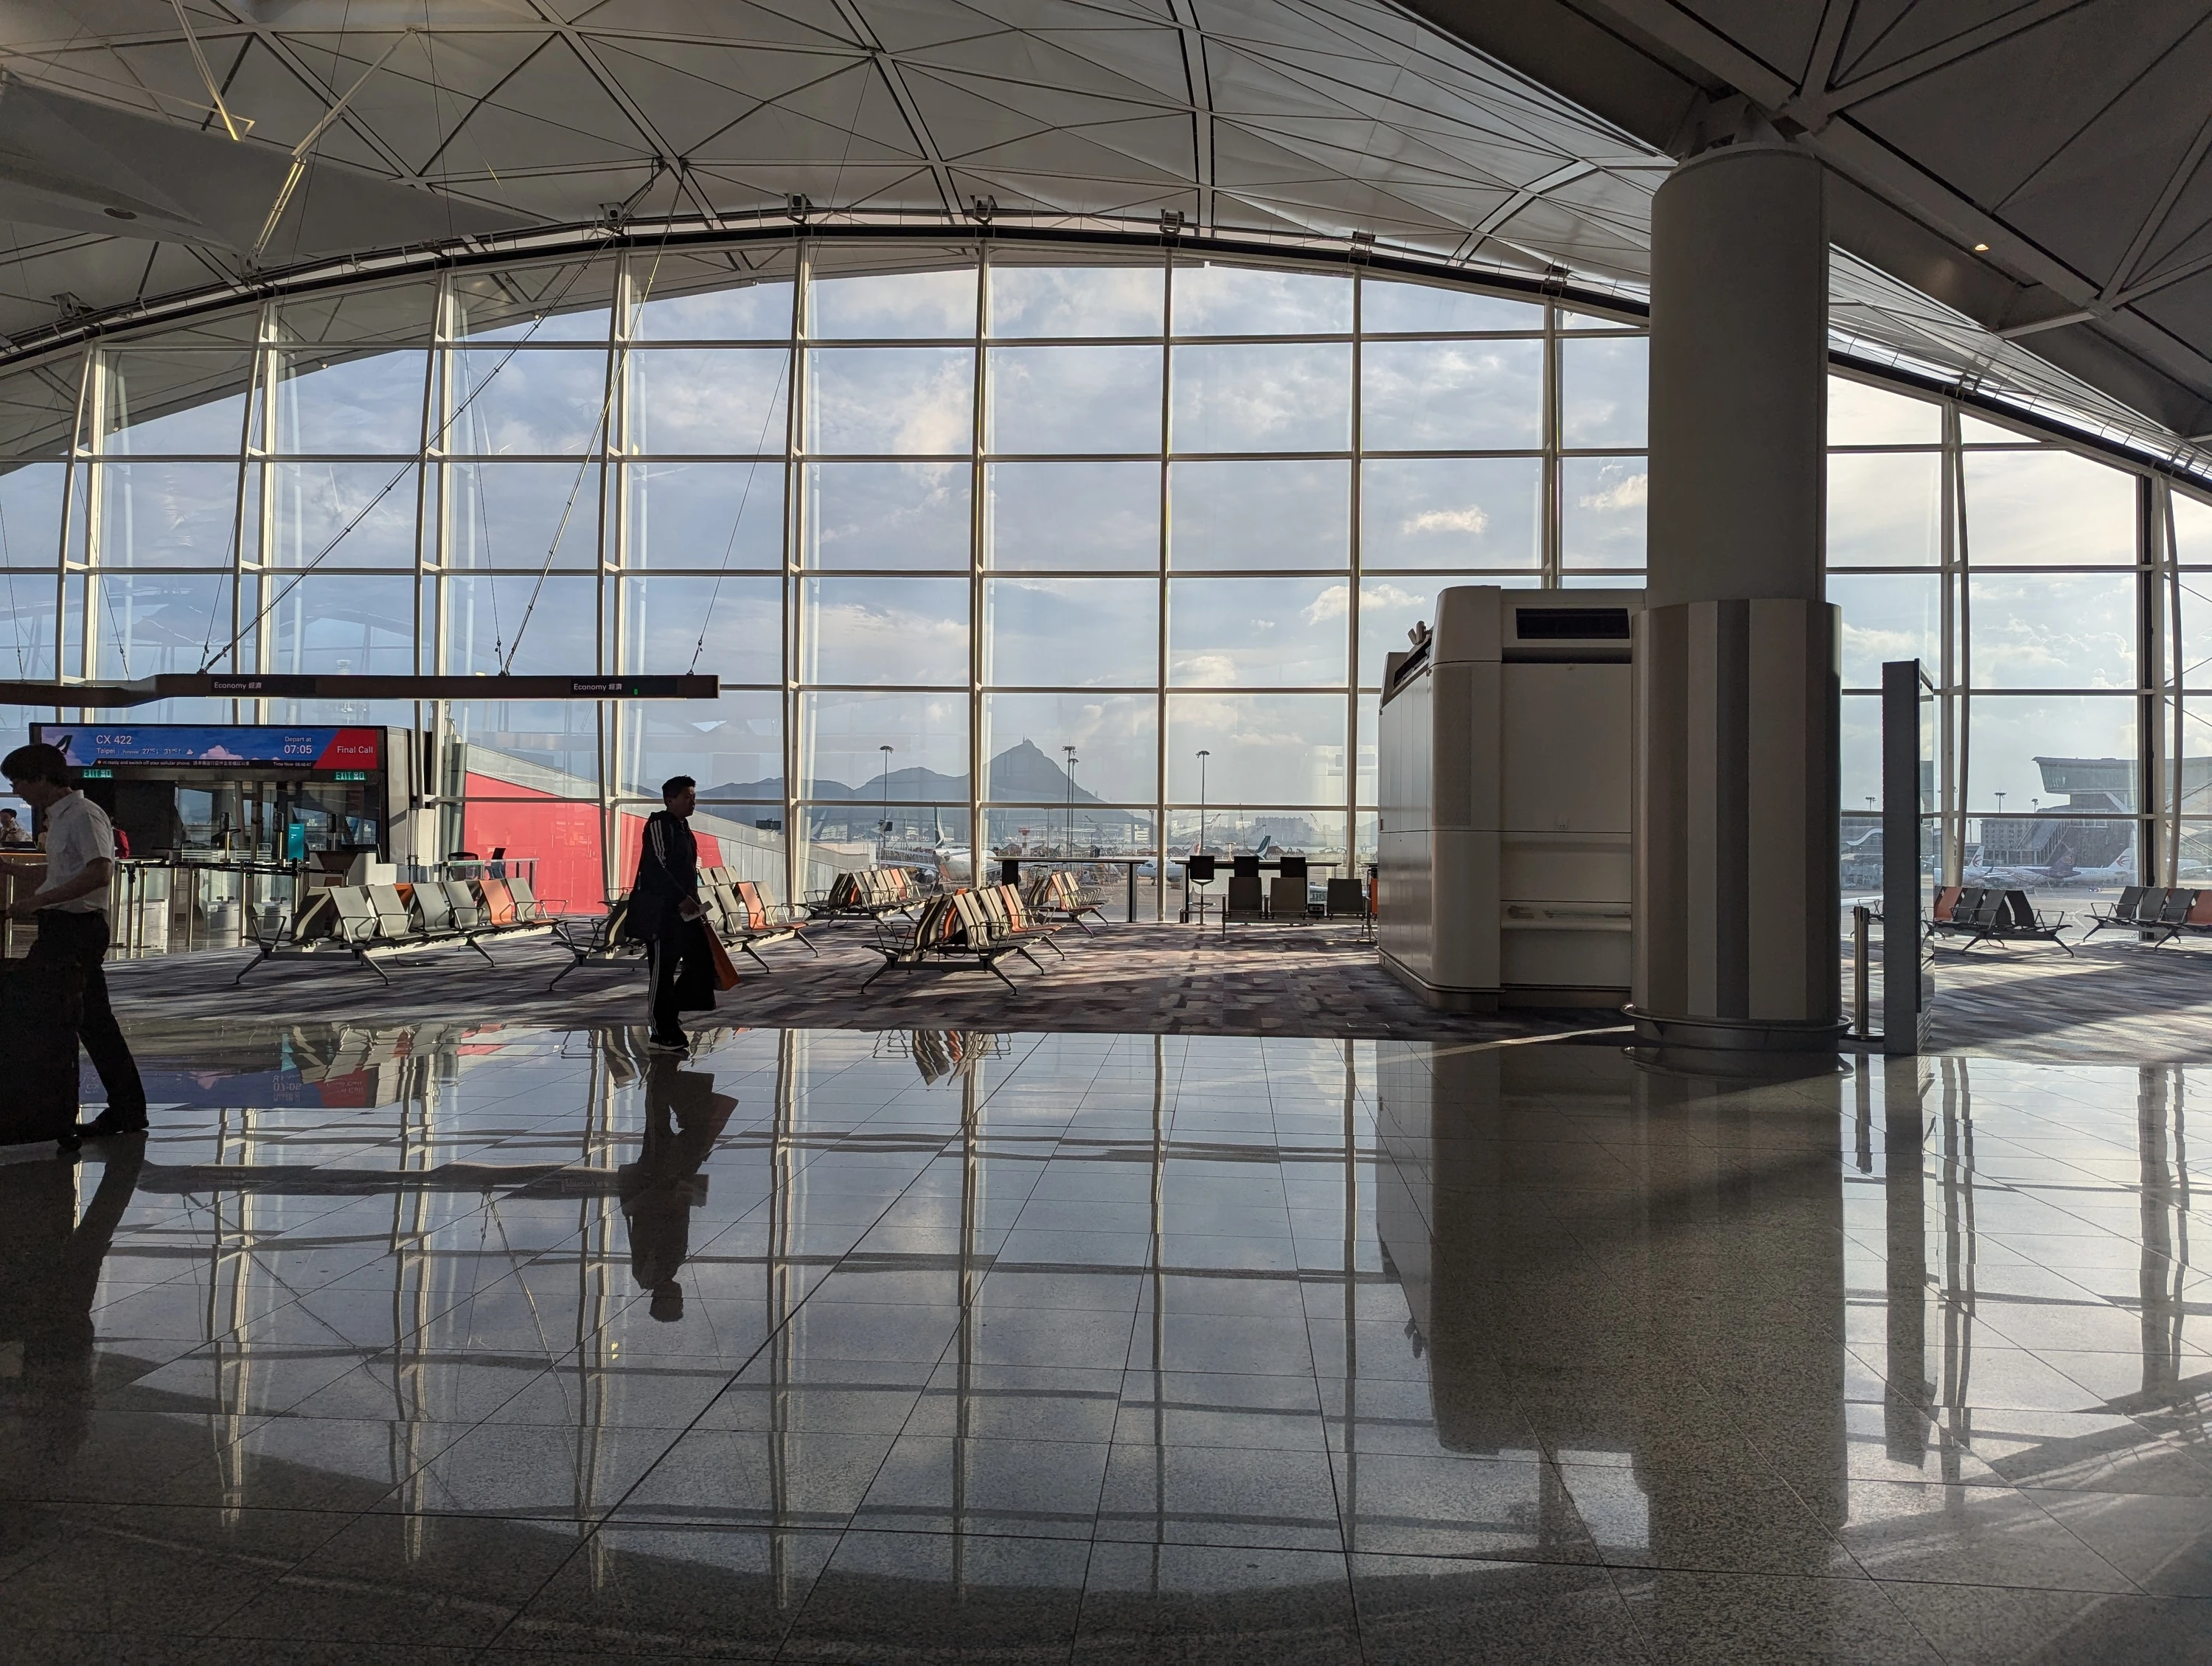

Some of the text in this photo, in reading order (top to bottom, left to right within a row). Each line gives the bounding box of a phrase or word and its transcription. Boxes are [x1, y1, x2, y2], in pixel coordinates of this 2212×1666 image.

[214, 681, 247, 690] Economy
[573, 683, 607, 692] Economy
[96, 735, 133, 745] CX 422
[284, 745, 312, 754] 07:05
[337, 746, 373, 754] Final Call
[83, 768, 112, 778] EXIT 出口
[335, 771, 365, 780] EXIT 出口
